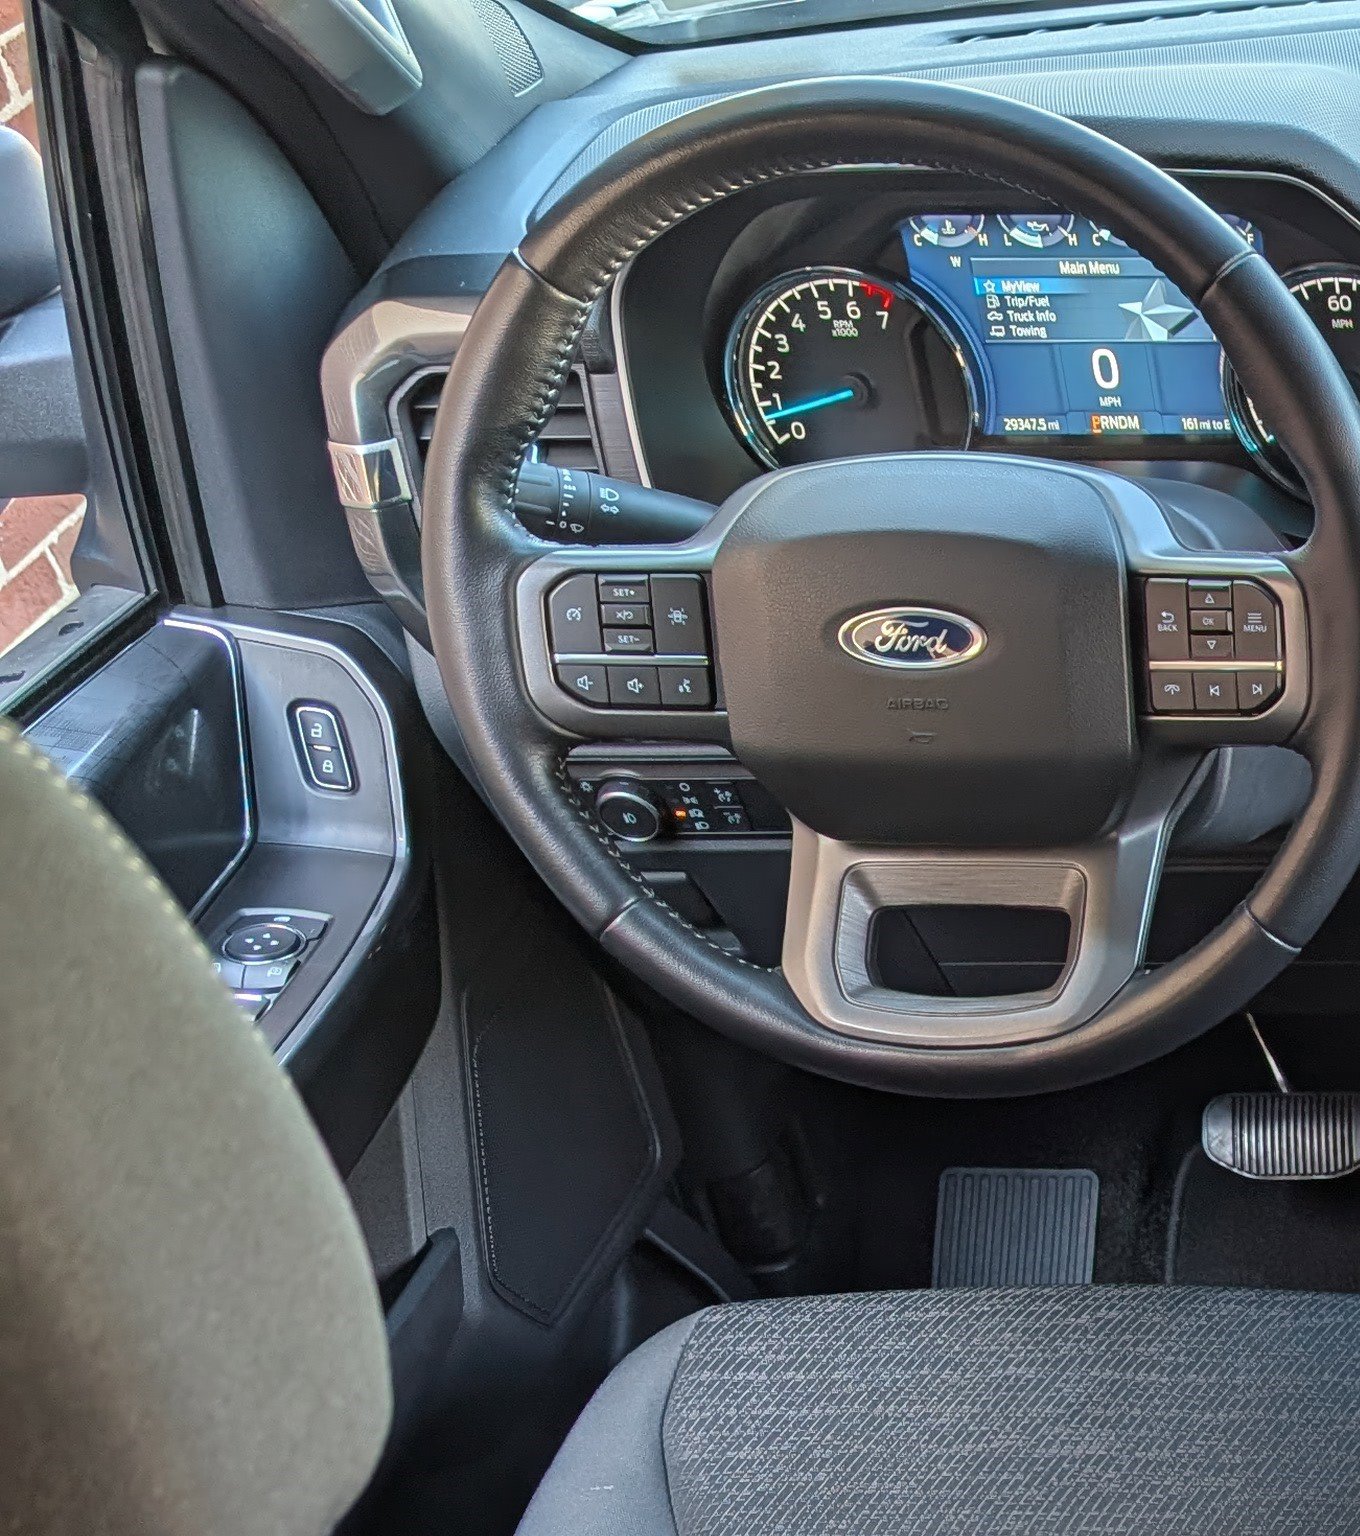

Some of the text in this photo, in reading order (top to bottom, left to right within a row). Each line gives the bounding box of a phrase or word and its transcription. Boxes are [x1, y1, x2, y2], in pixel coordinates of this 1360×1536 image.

[914, 234, 923, 246] C
[979, 233, 988, 246] H
[1004, 234, 1012, 246] L
[1067, 233, 1077, 246] H
[1092, 233, 1101, 246] C
[950, 256, 961, 268] W
[1059, 261, 1120, 275] Main Menu
[1001, 280, 1040, 294] MyView
[1004, 295, 1051, 308] Trip/Fuel
[1327, 295, 1352, 313] 60
[817, 301, 832, 320] 5
[846, 301, 861, 320] 6
[1006, 310, 1057, 323] Truck Info
[791, 314, 806, 332] 4
[832, 320, 854, 329] RPM
[875, 311, 889, 330] 7
[1332, 318, 1353, 330] MPH
[1009, 325, 1047, 338] Towing
[774, 334, 790, 353] 3
[768, 361, 782, 380] 2
[1091, 348, 1120, 389] 0
[771, 393, 782, 410] 1
[1099, 396, 1122, 407] MPH
[791, 421, 806, 440] 0
[1003, 418, 1060, 432] 29347.5 mi
[1181, 418, 1199, 431] 161
[1199, 419, 1211, 431] mi
[1212, 420, 1223, 431] to
[1157, 624, 1178, 632] BACK
[1202, 617, 1215, 626] OK
[1243, 625, 1267, 633] MENU
[875, 620, 948, 653] Ford
[886, 698, 949, 710] AIRBAG
